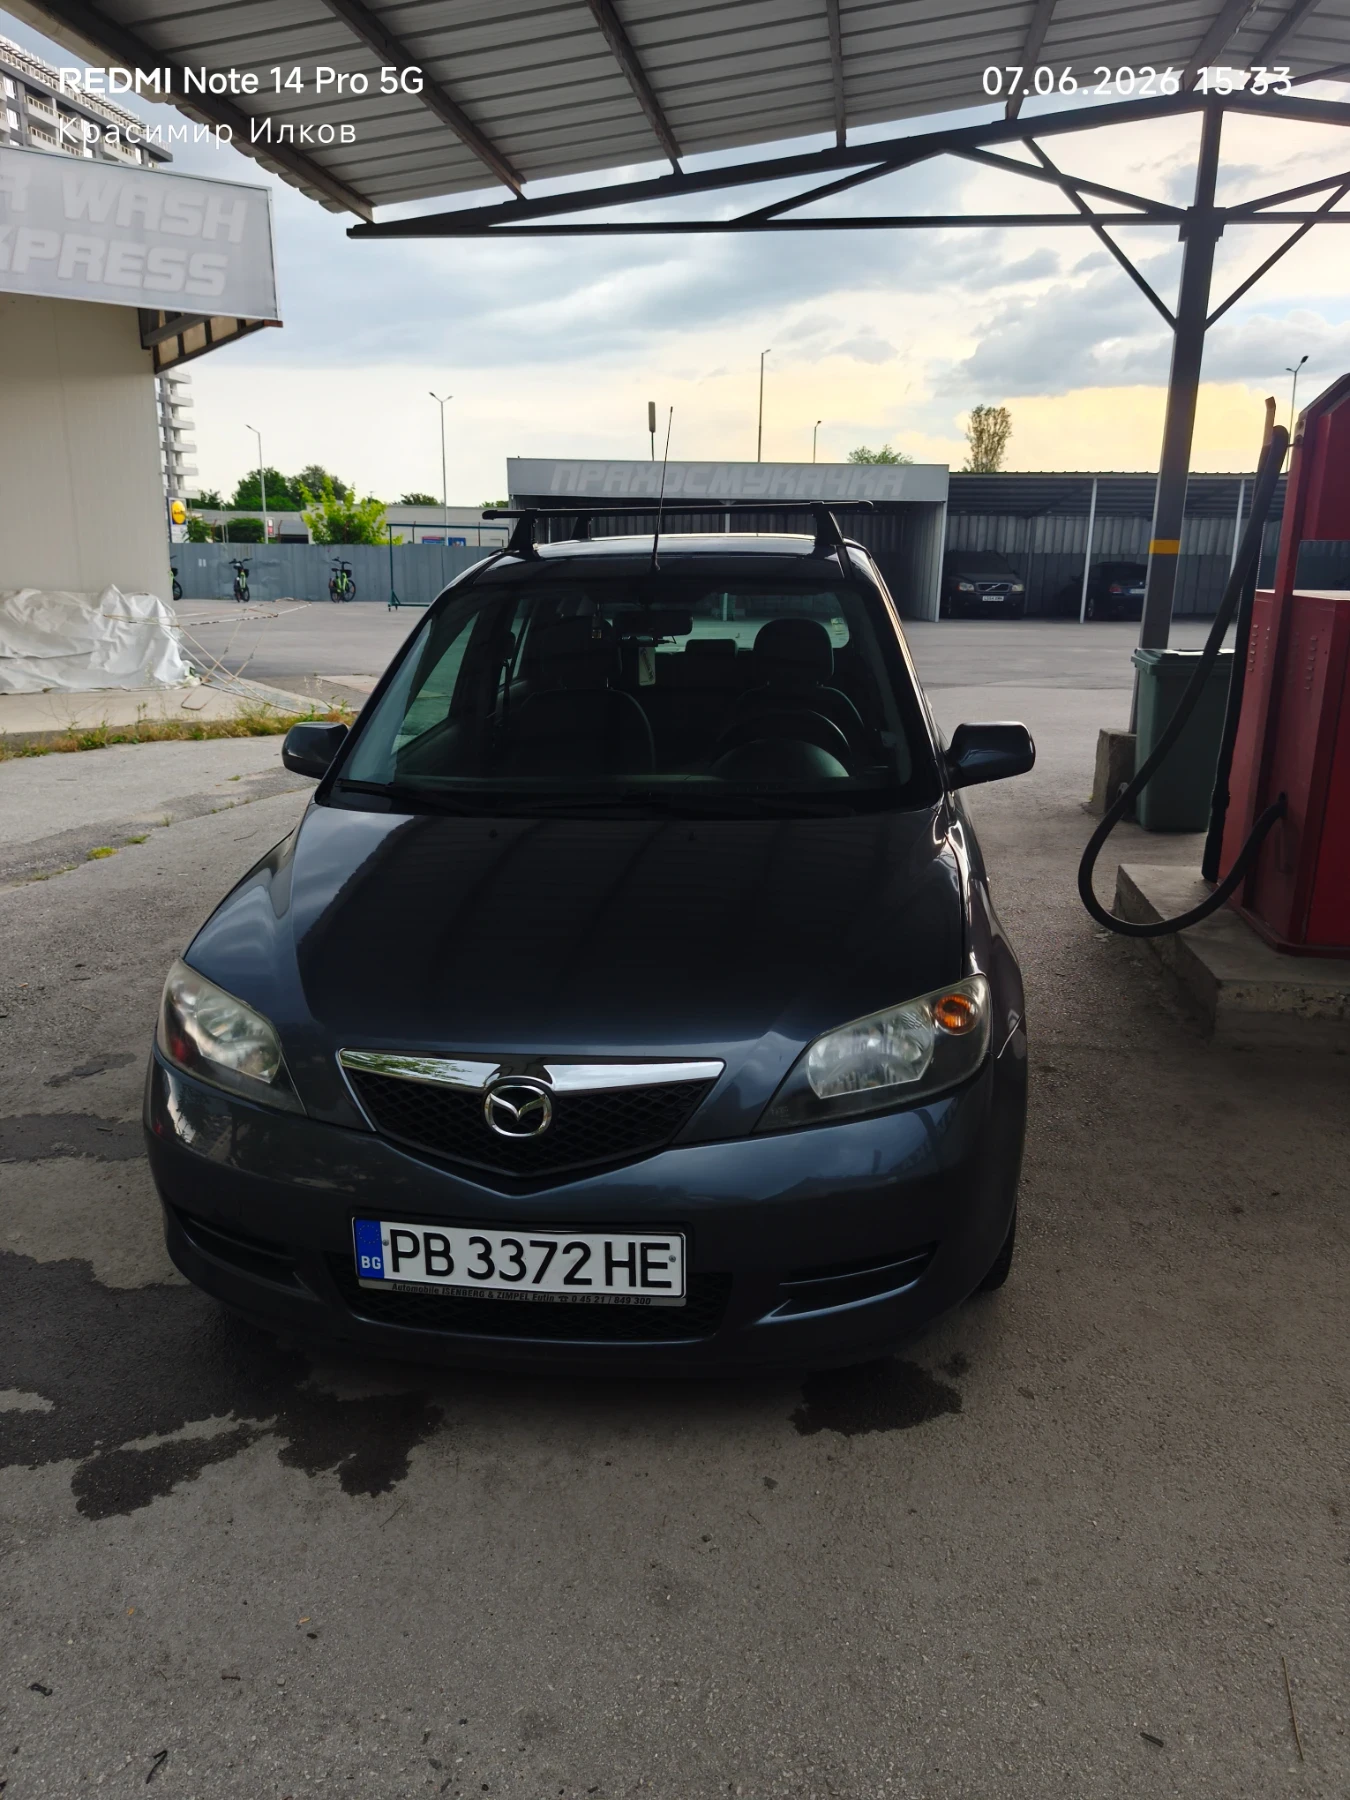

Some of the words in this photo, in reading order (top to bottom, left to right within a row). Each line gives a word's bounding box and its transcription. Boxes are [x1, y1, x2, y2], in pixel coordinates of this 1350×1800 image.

[61, 172, 248, 244] WASH
[550, 462, 909, 496] ПРАХОСМУКАЧКА
[361, 1255, 382, 1270] BG
[389, 1228, 455, 1277] PB
[467, 1236, 593, 1286] 3372
[604, 1241, 673, 1289] HE
[392, 1283, 440, 1294] Automobile
[487, 1290, 494, 1299] &
[579, 1295, 592, 1303] 45
